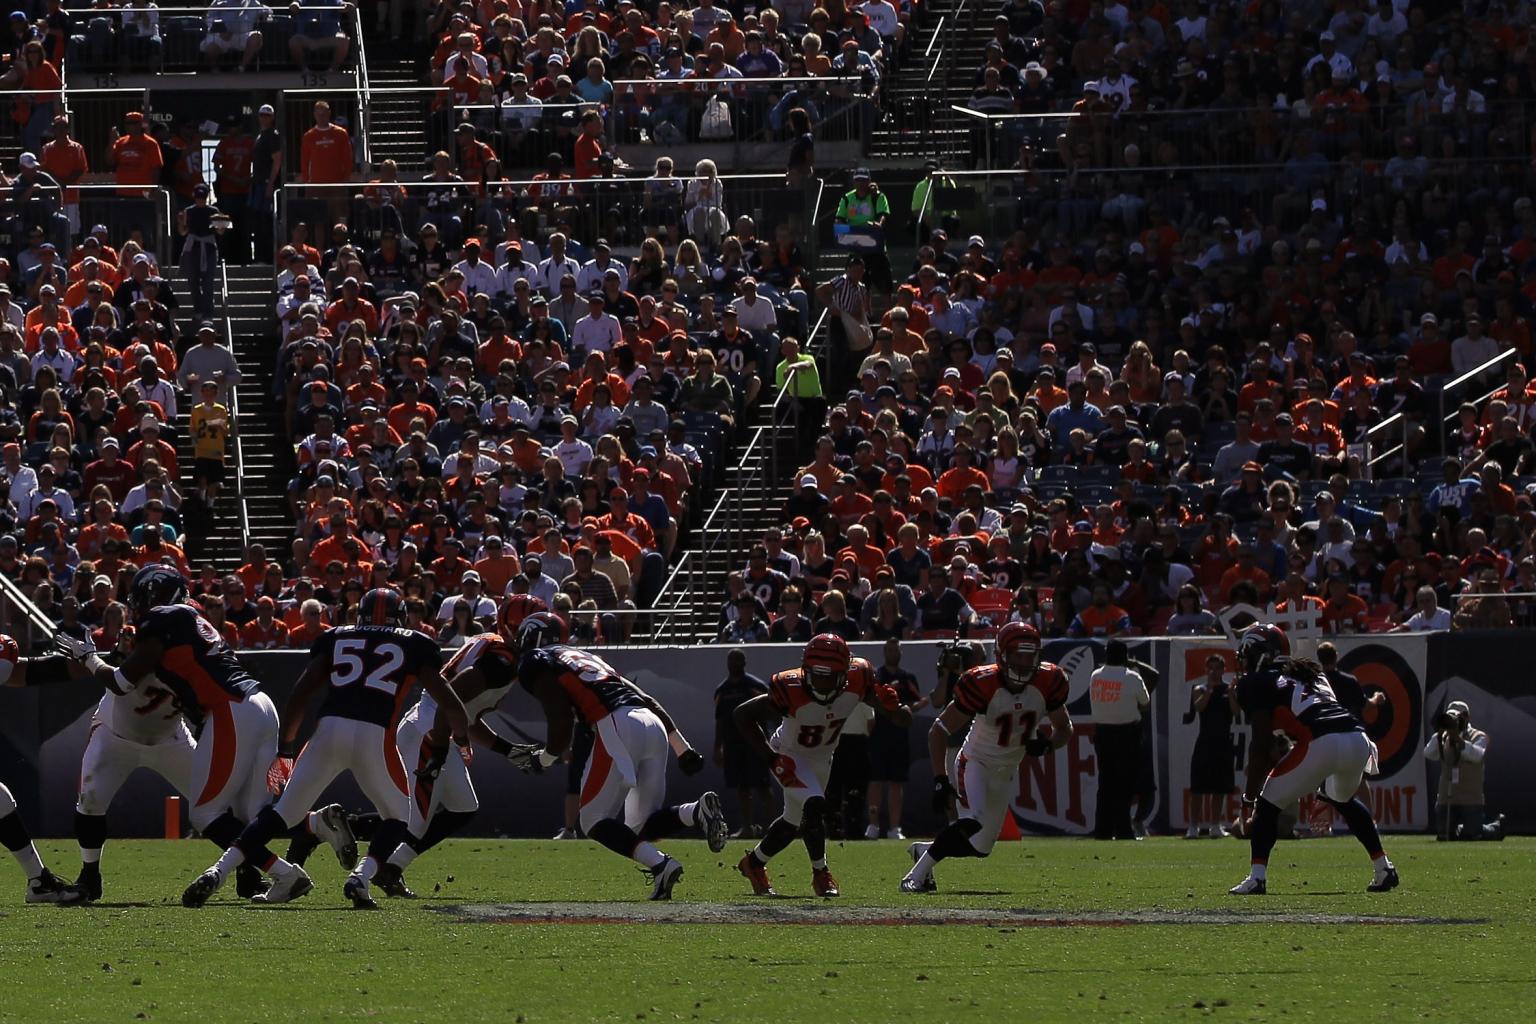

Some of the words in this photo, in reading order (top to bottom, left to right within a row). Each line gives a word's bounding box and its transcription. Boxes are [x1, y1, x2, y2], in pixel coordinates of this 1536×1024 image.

[94, 76, 119, 88] 135
[301, 75, 328, 87] 135
[233, 155, 242, 170] 7
[718, 349, 744, 372] 20
[1394, 395, 1407, 414] 7
[330, 638, 405, 696] 52
[797, 716, 849, 749] 87
[995, 710, 1038, 747] 11
[1015, 723, 1096, 828] NF
